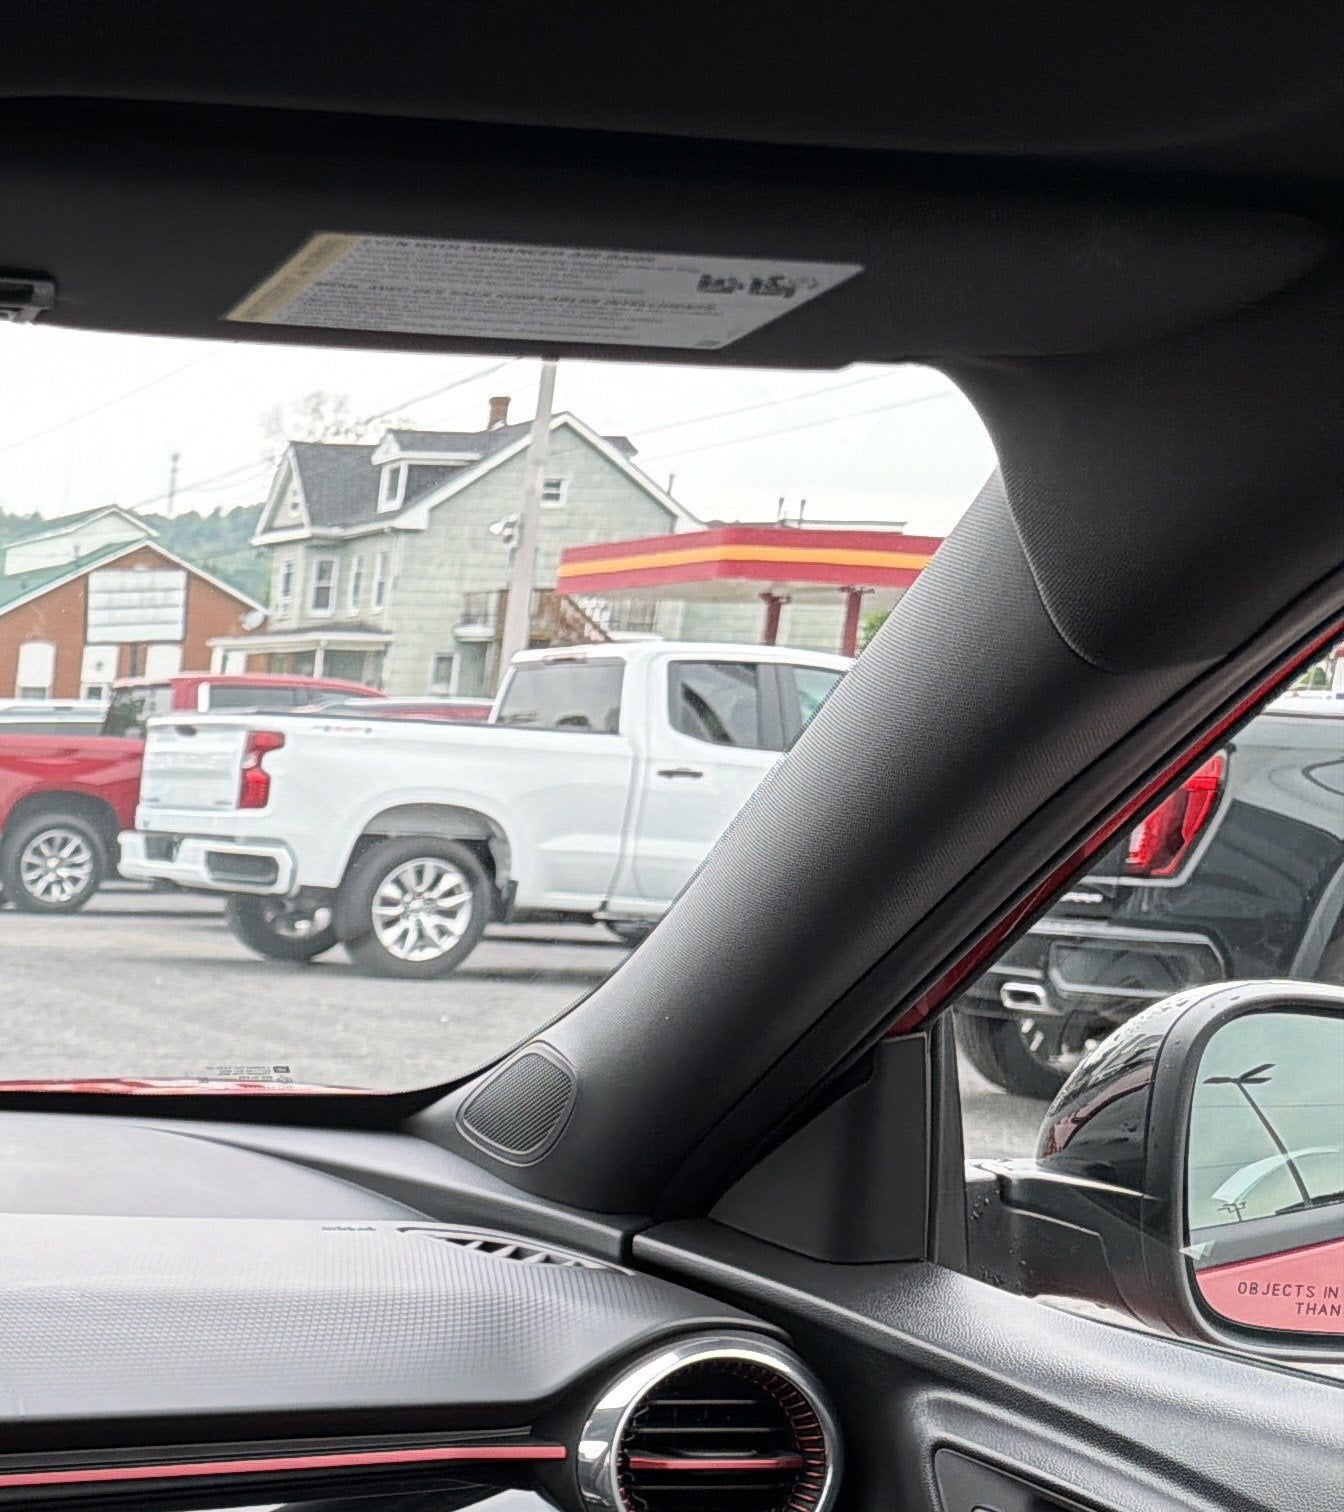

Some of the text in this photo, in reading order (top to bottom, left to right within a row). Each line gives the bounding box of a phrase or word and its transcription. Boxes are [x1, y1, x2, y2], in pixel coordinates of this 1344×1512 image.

[1237, 1281, 1339, 1300] OBJECTS IN
[1295, 1302, 1341, 1317] THAN
